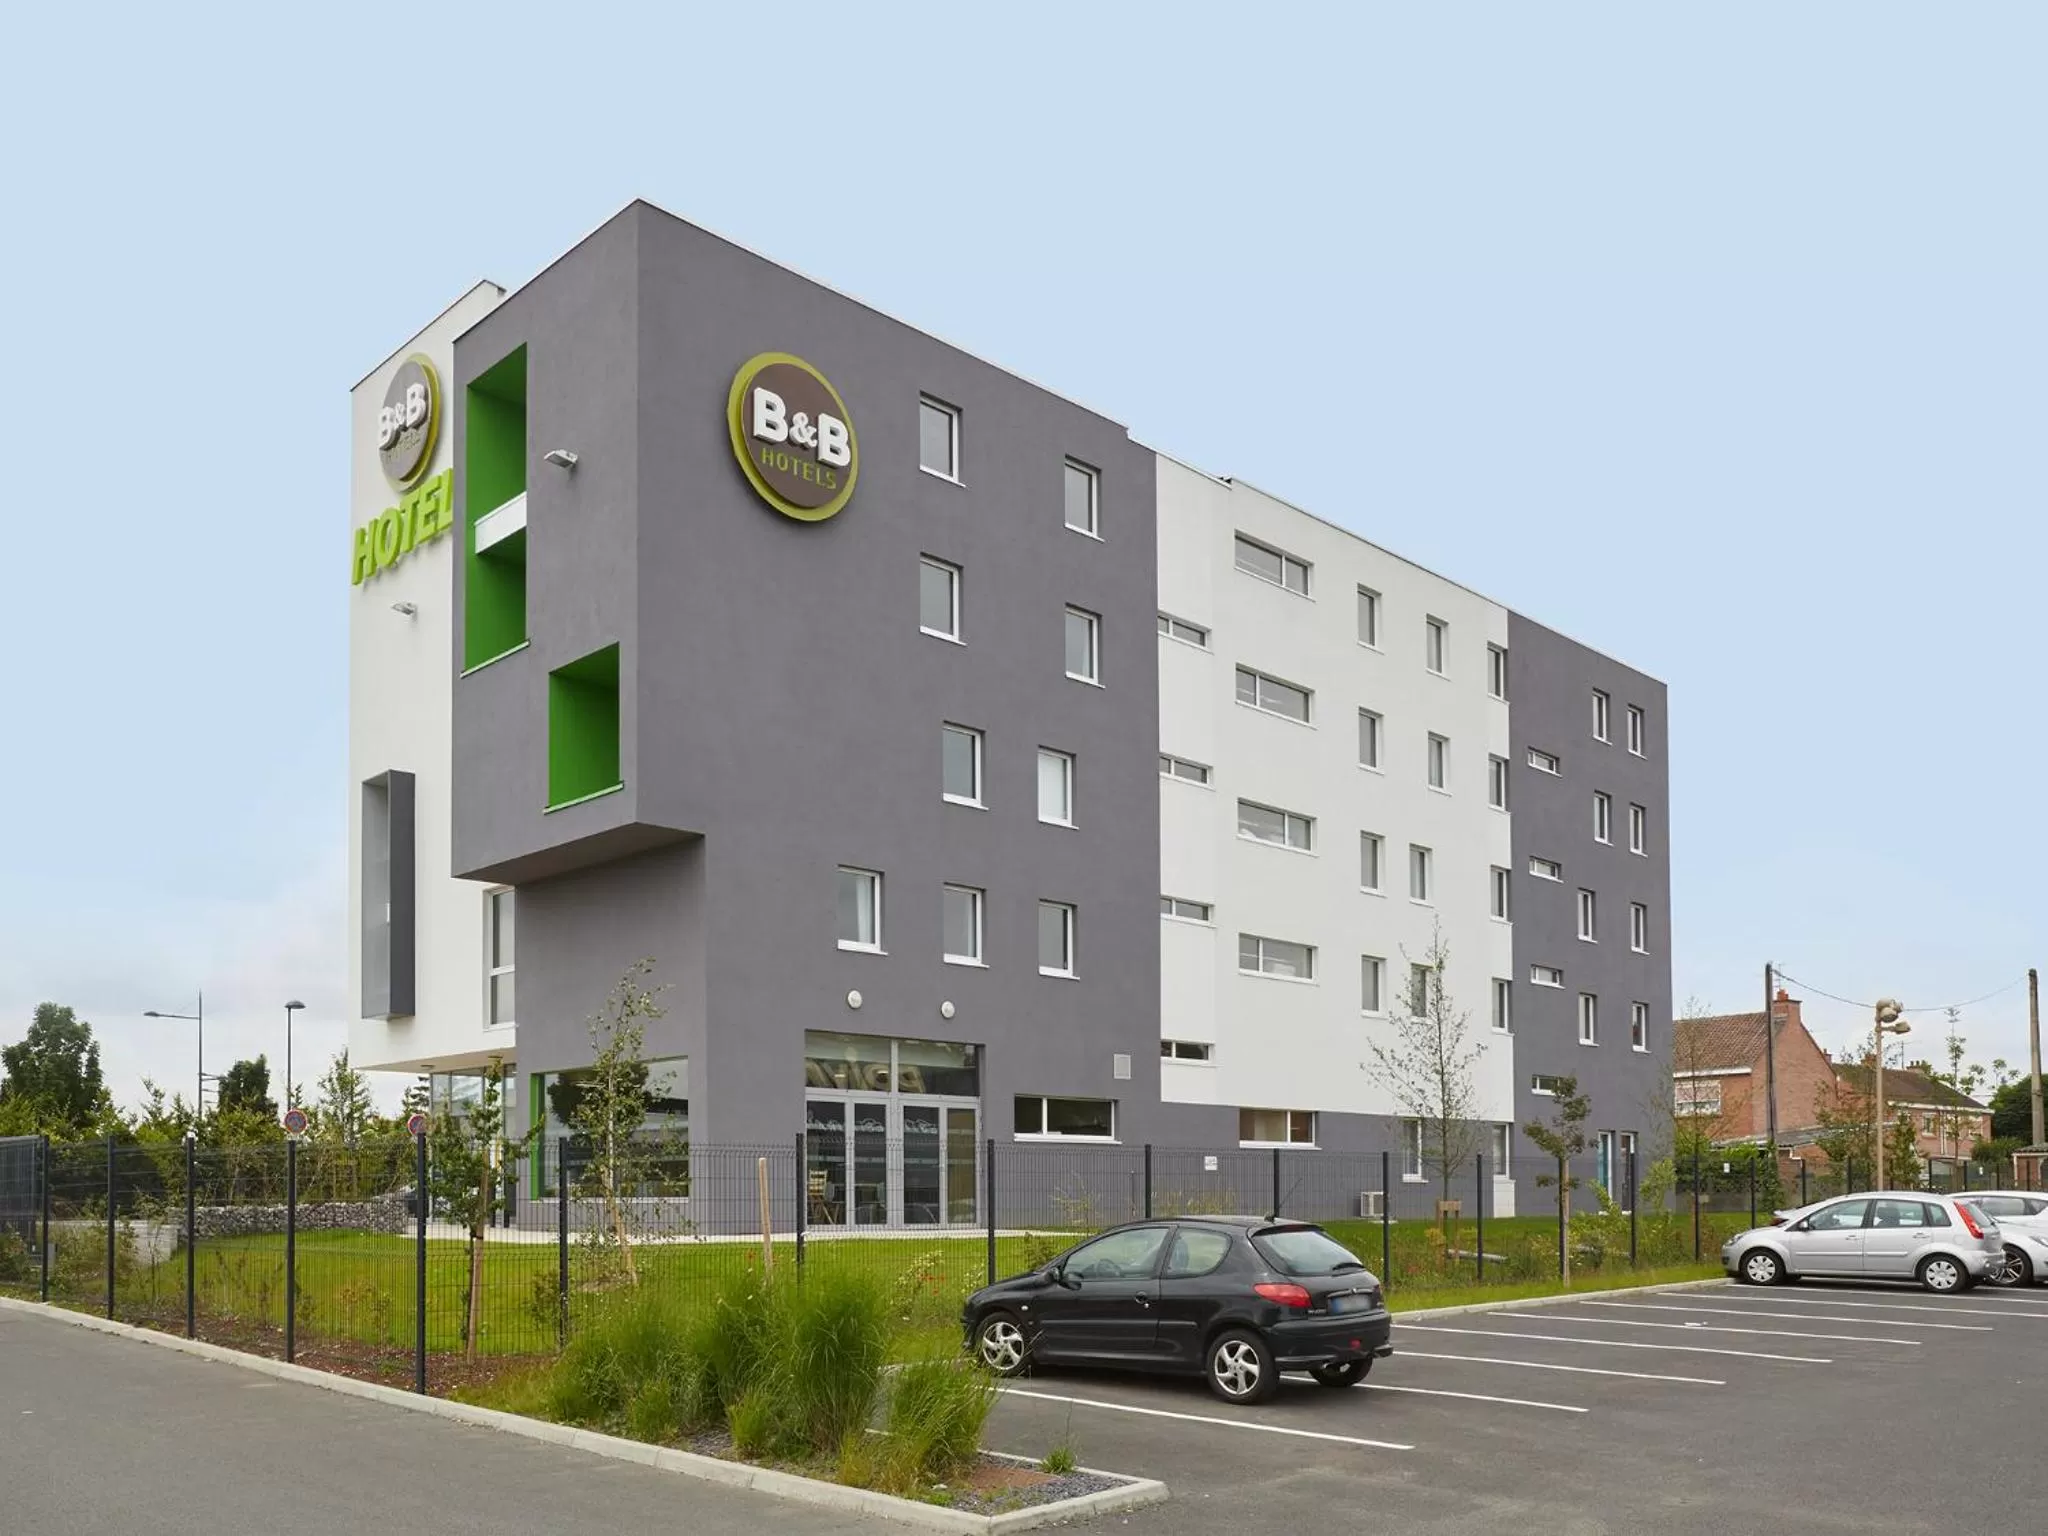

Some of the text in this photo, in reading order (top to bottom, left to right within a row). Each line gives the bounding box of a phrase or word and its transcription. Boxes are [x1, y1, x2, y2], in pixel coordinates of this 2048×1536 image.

[378, 383, 426, 448] B&B
[753, 387, 851, 466] B&B
[762, 448, 837, 489] HOTELS
[352, 467, 453, 585] HOTEL
